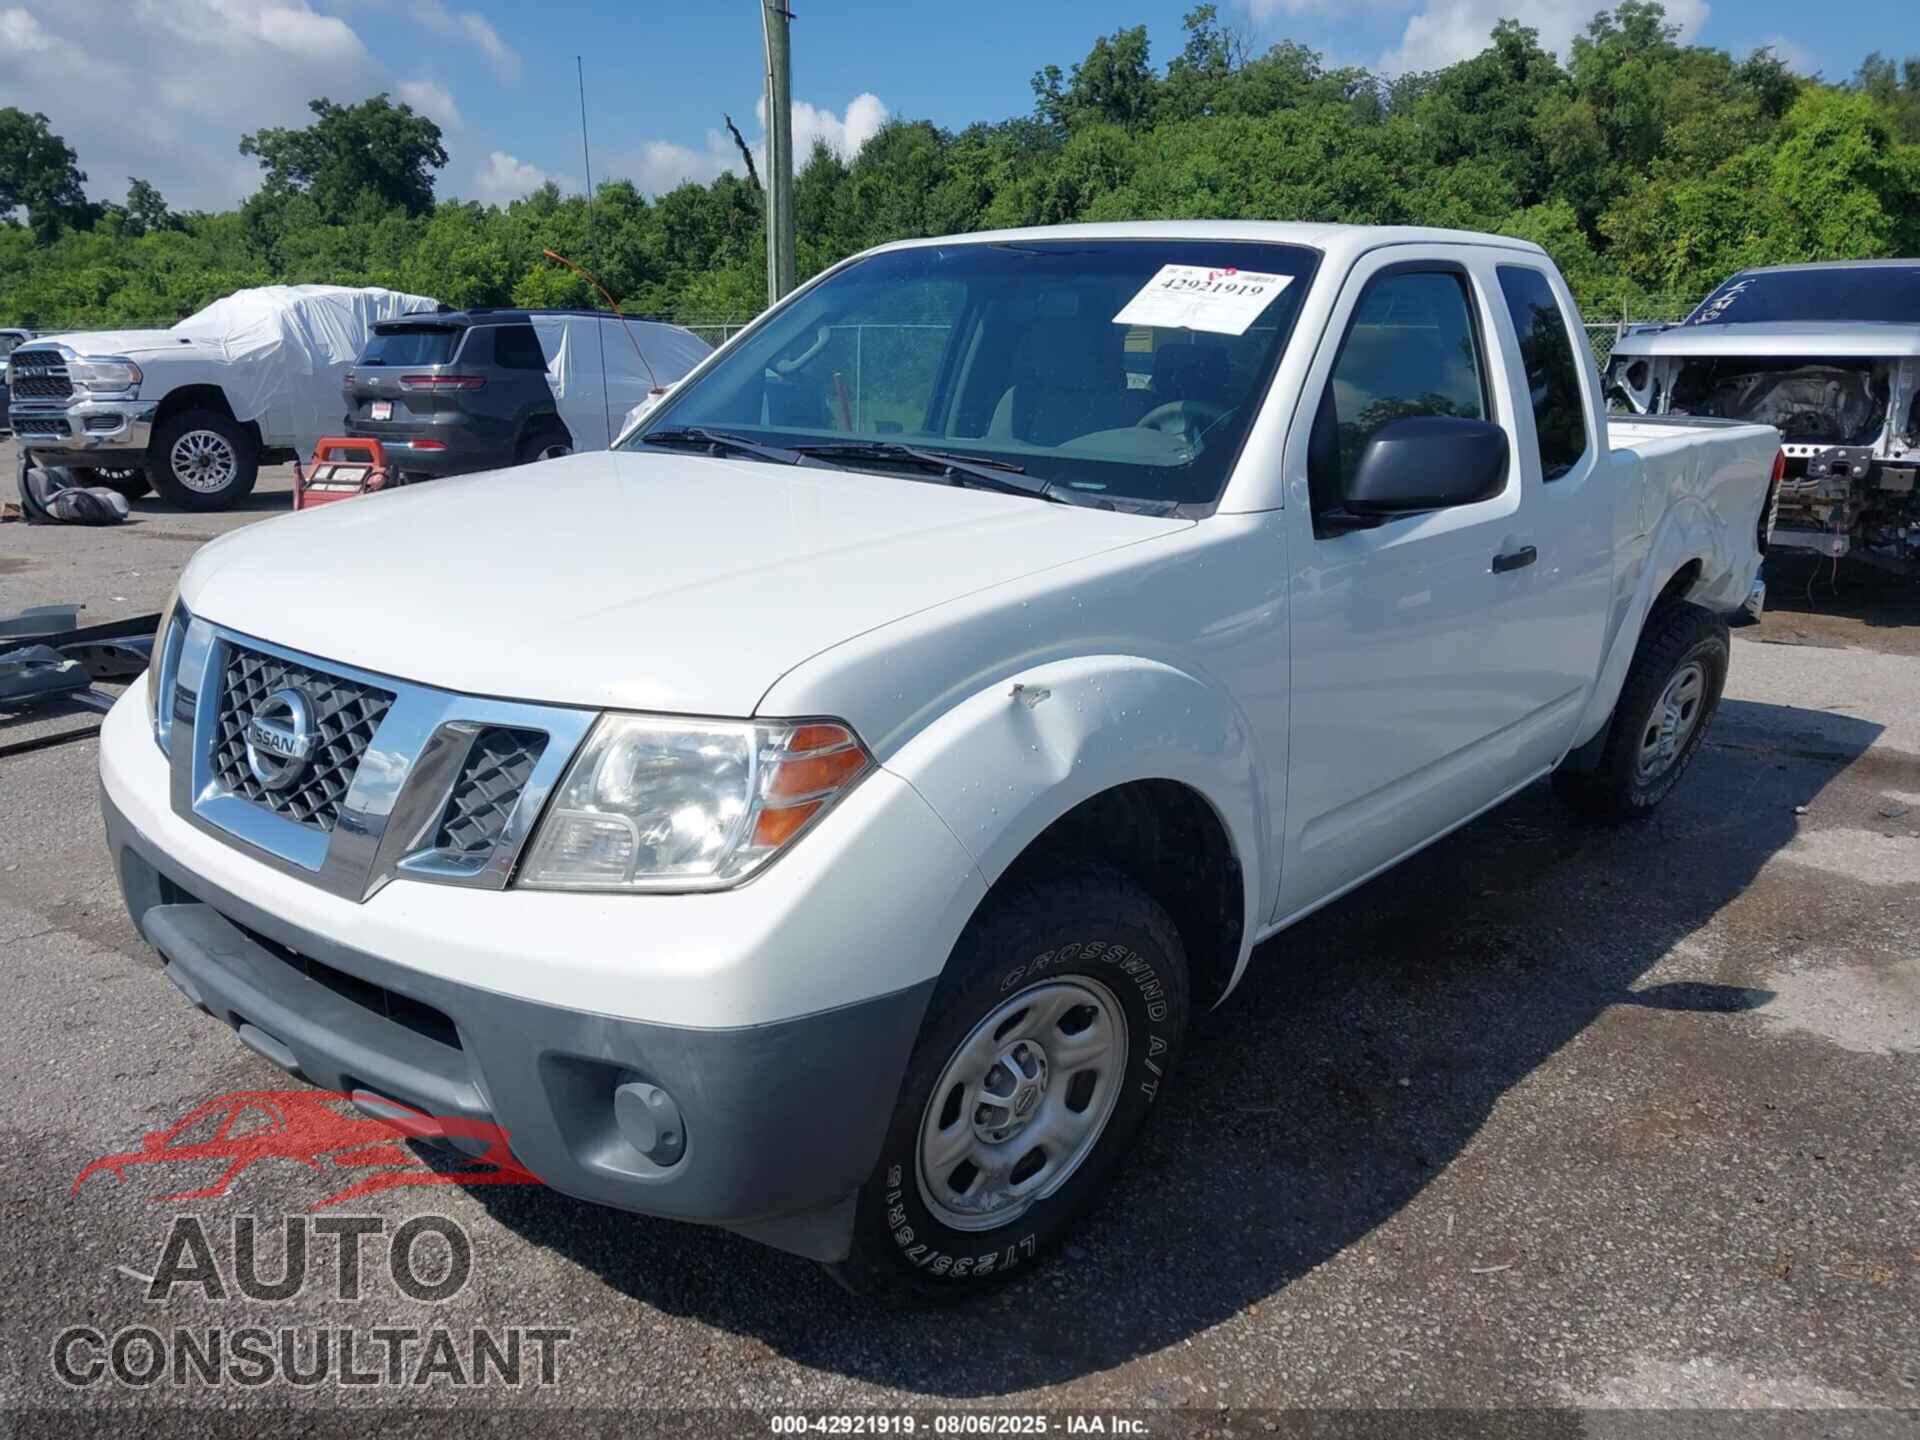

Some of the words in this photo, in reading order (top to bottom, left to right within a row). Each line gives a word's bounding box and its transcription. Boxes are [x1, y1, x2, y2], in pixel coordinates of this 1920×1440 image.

[1161, 277, 1265, 297] 42921919
[1000, 940, 1169, 1024] CROSSWIND
[1140, 1035, 1168, 1104] A/T
